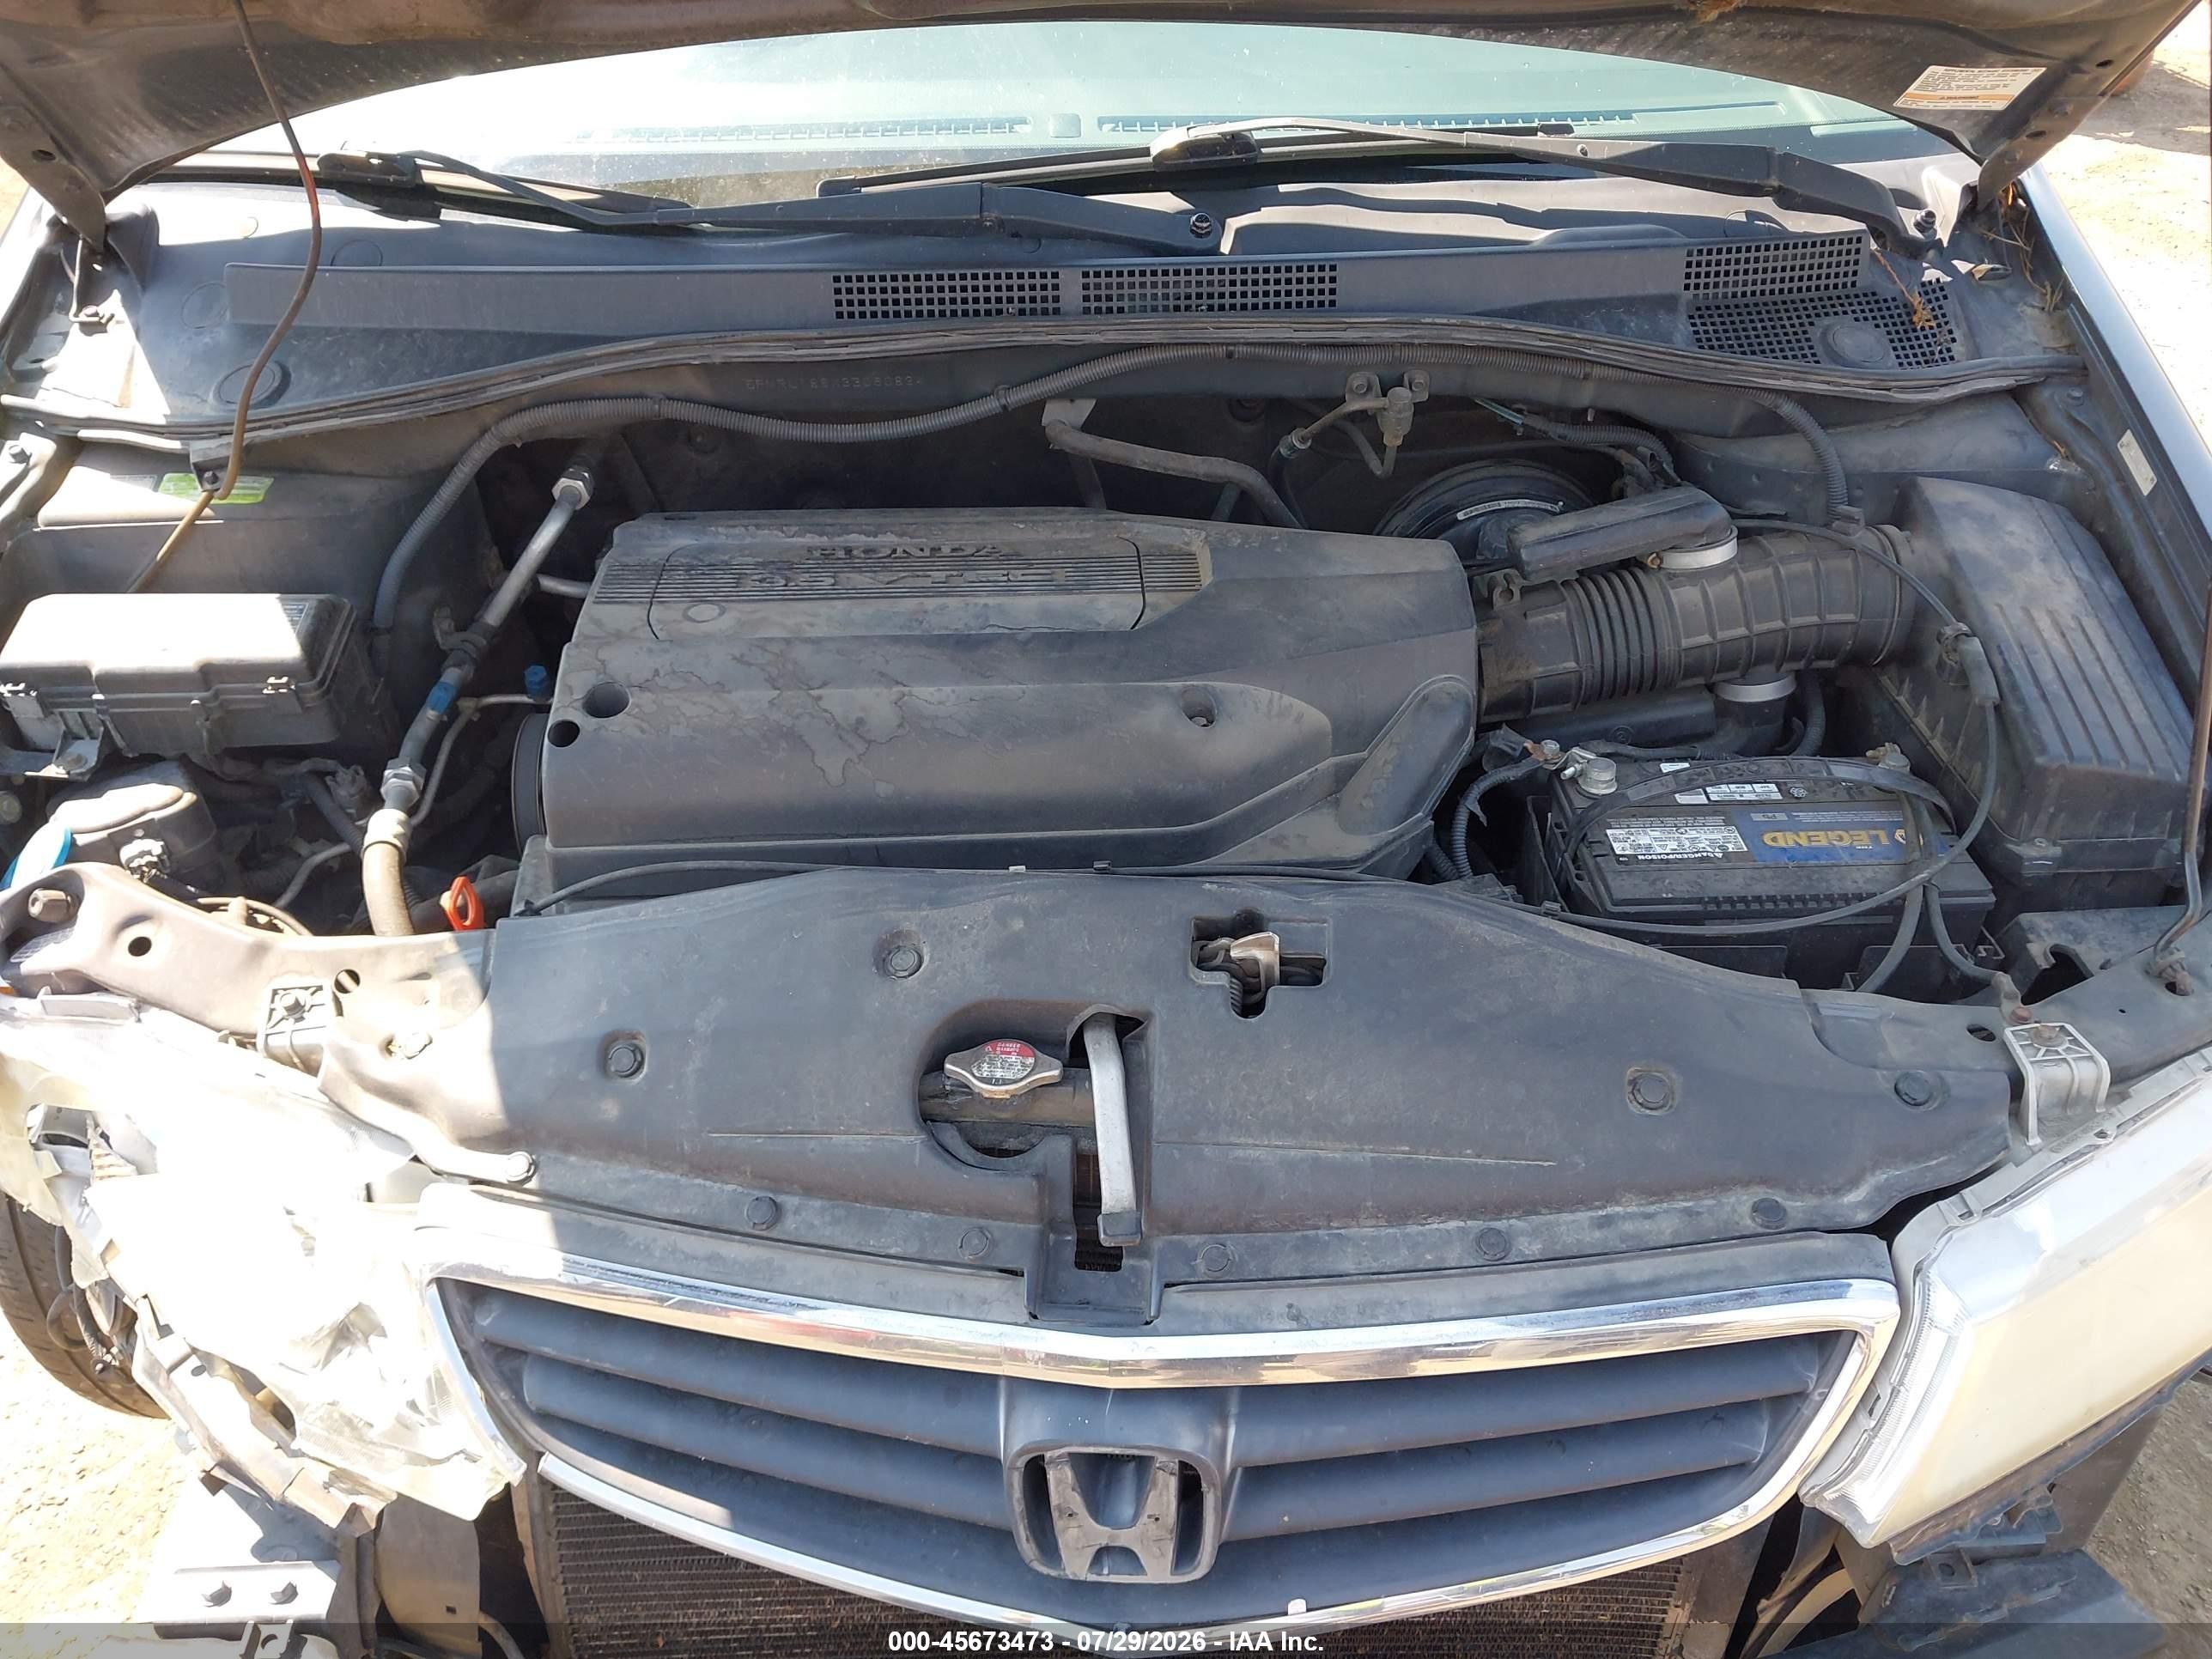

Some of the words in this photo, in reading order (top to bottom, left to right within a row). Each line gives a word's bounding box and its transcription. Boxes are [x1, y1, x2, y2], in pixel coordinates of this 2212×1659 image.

[805, 544, 1024, 560] HONDA
[1761, 830, 1890, 848] LEGEND
[1636, 852, 1717, 860] DANGER/POISON
